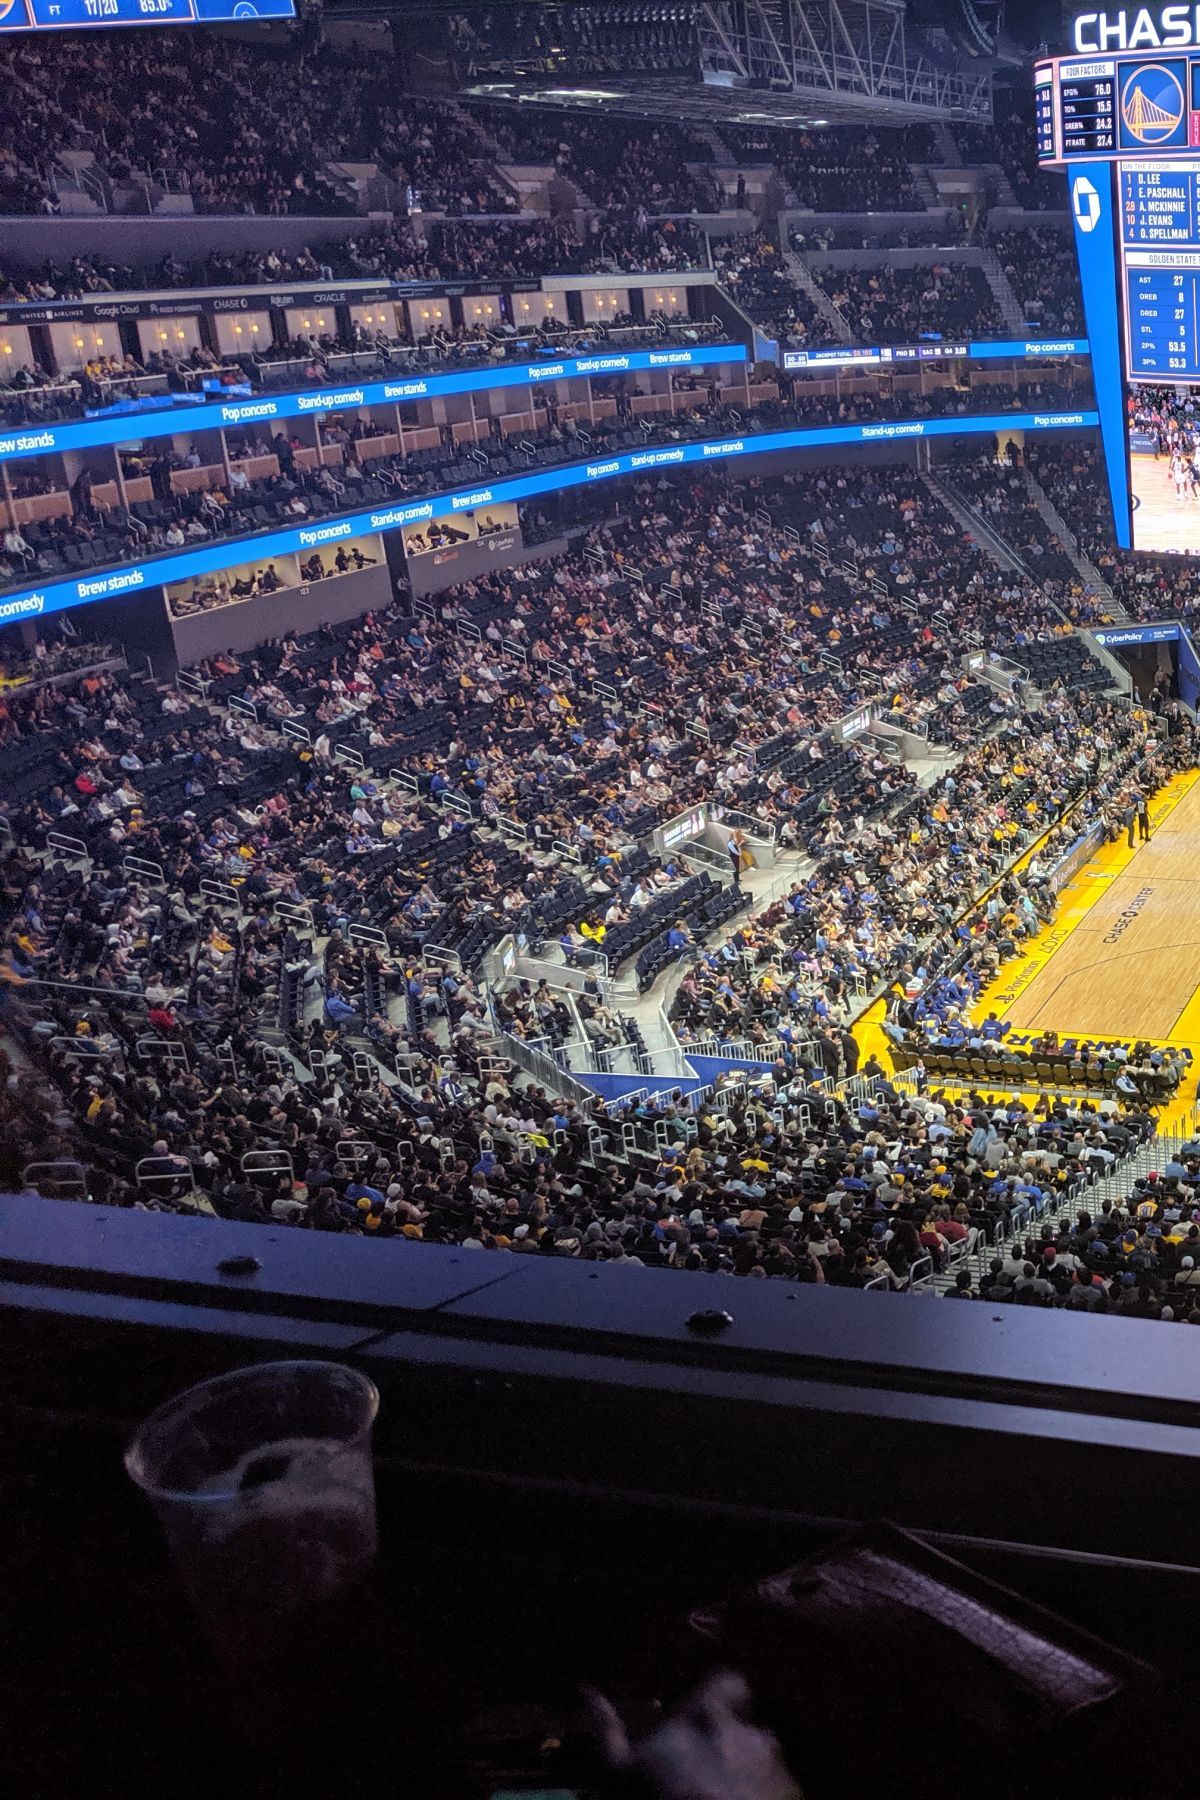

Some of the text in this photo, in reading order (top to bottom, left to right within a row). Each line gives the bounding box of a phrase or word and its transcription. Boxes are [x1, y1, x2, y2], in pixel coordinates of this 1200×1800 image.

[50, 6, 60, 15] FT
[1066, 65, 1106, 77] FOUR FACTORS
[1064, 84, 1111, 96] EFG% 76.0
[1097, 100, 1111, 112] 15.5
[1096, 118, 1112, 130] 24.2
[1072, 138, 1085, 146] RATE
[1097, 135, 1112, 147] 27.4
[1147, 173, 1161, 184] LEE
[1147, 188, 1186, 198] PASCHALL
[1148, 202, 1185, 212] MCKINNIE
[1148, 215, 1173, 226] EVANS
[1149, 229, 1189, 239] SPELLMAN
[1149, 255, 1174, 264] GOLDEN
[1176, 255, 1196, 264] STATE
[314, 293, 346, 303] ORACLE
[93, 306, 119, 317] Google
[120, 304, 139, 314] Cloud
[213, 300, 240, 309] CHASE
[1026, 343, 1074, 354] Pop concerts
[577, 357, 629, 370] Stand-up comedy
[650, 352, 691, 363] Brew stands
[529, 365, 563, 379] Pop concerts
[385, 382, 426, 397] Brew stands
[298, 390, 363, 409] Stand-up comedy
[222, 403, 276, 422] Pop concerts
[1035, 416, 1082, 426] Pop concerts
[862, 424, 924, 436] Stand-up comedy
[0, 432, 54, 452] ew stands
[704, 441, 743, 454] Brew stands
[632, 450, 683, 466] Stand-up comedy
[587, 463, 619, 477] Pop concerts
[452, 490, 492, 508] Brew stands
[371, 504, 432, 527] Stand-up comedy
[300, 524, 351, 545] Pop concerts
[78, 571, 143, 597] Brew stands
[0, 594, 44, 616] comedy
[1106, 632, 1142, 643] CyberPolicy
[1103, 887, 1153, 943] CHASE CENTER
[1005, 960, 1041, 992] PlayStation
